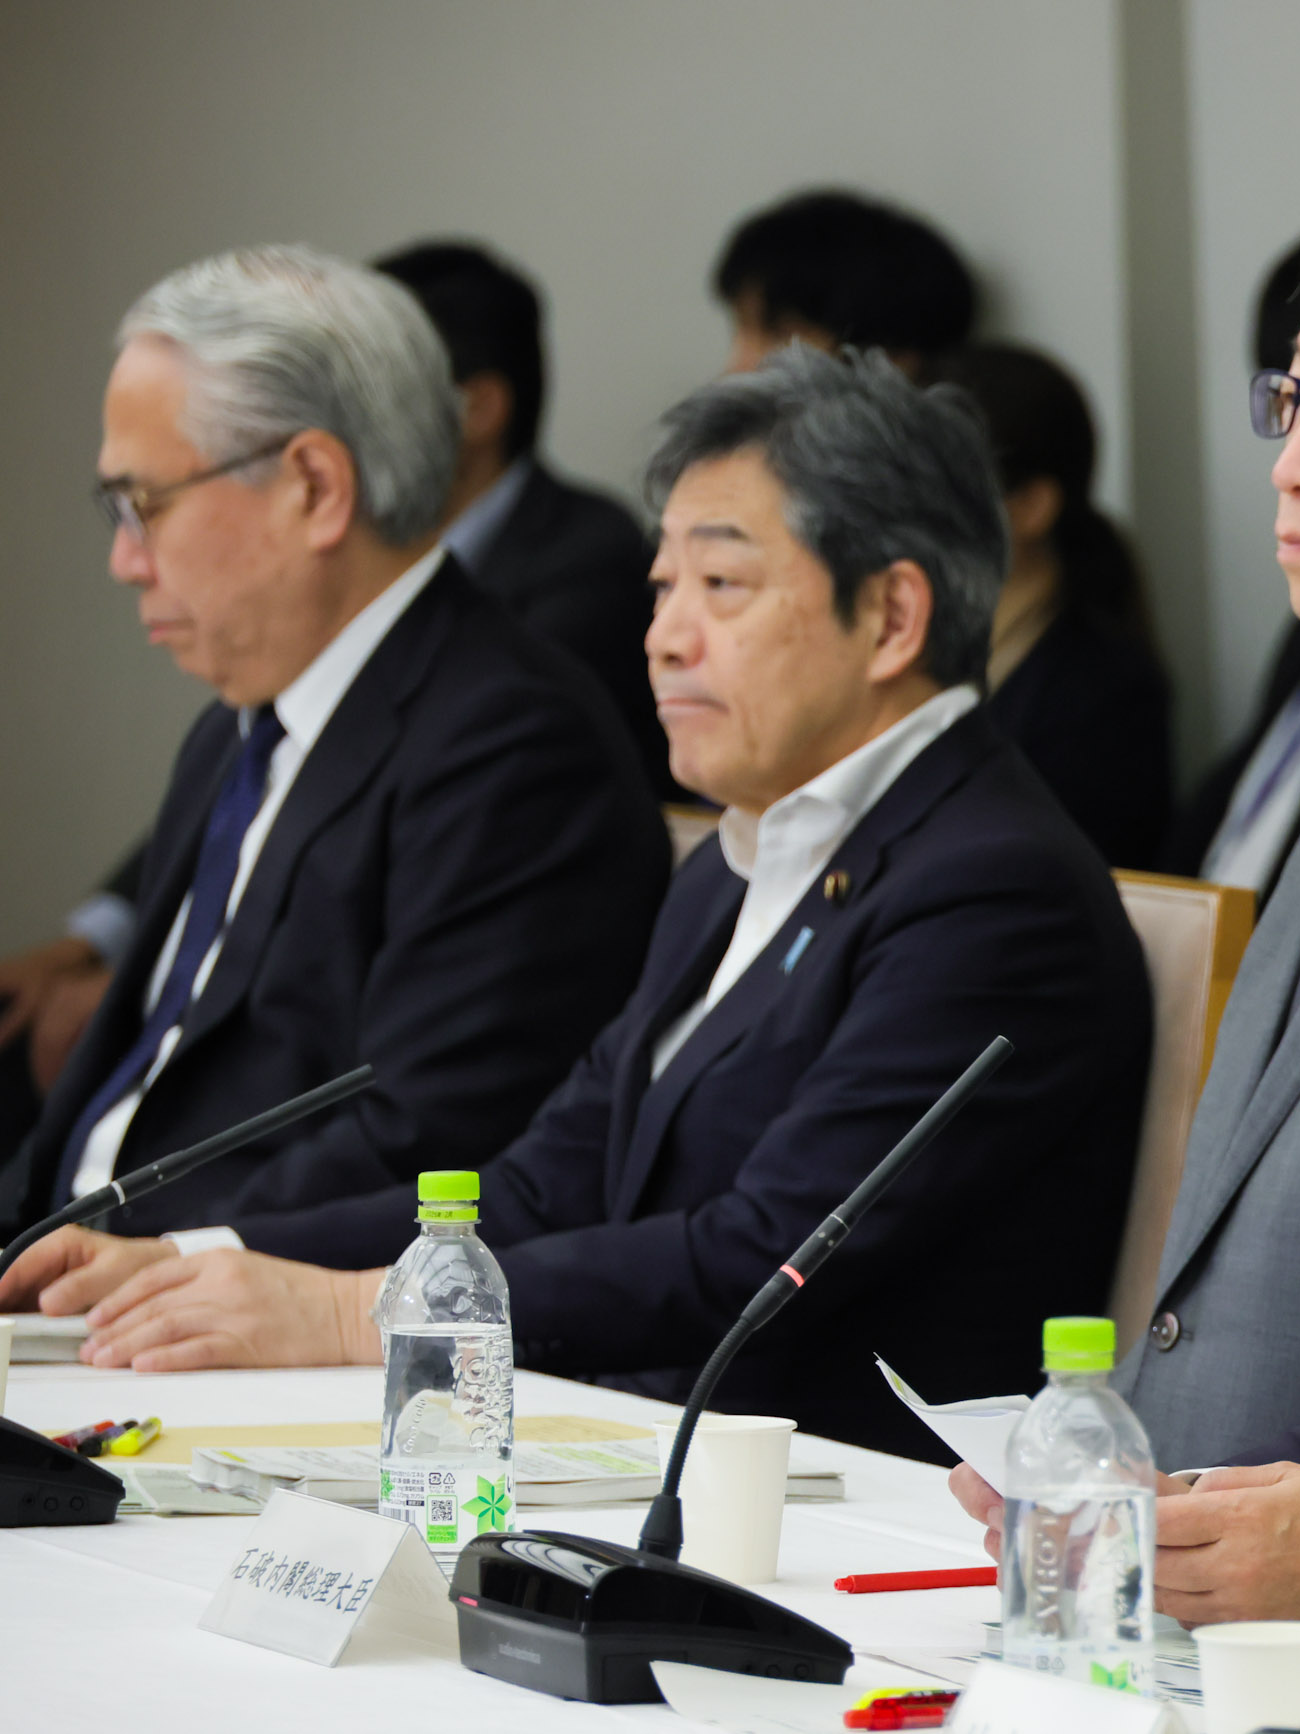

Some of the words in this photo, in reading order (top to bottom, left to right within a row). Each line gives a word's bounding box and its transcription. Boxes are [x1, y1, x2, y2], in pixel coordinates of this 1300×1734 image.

[231, 1547, 374, 1614] 石破内閣総理大臣
